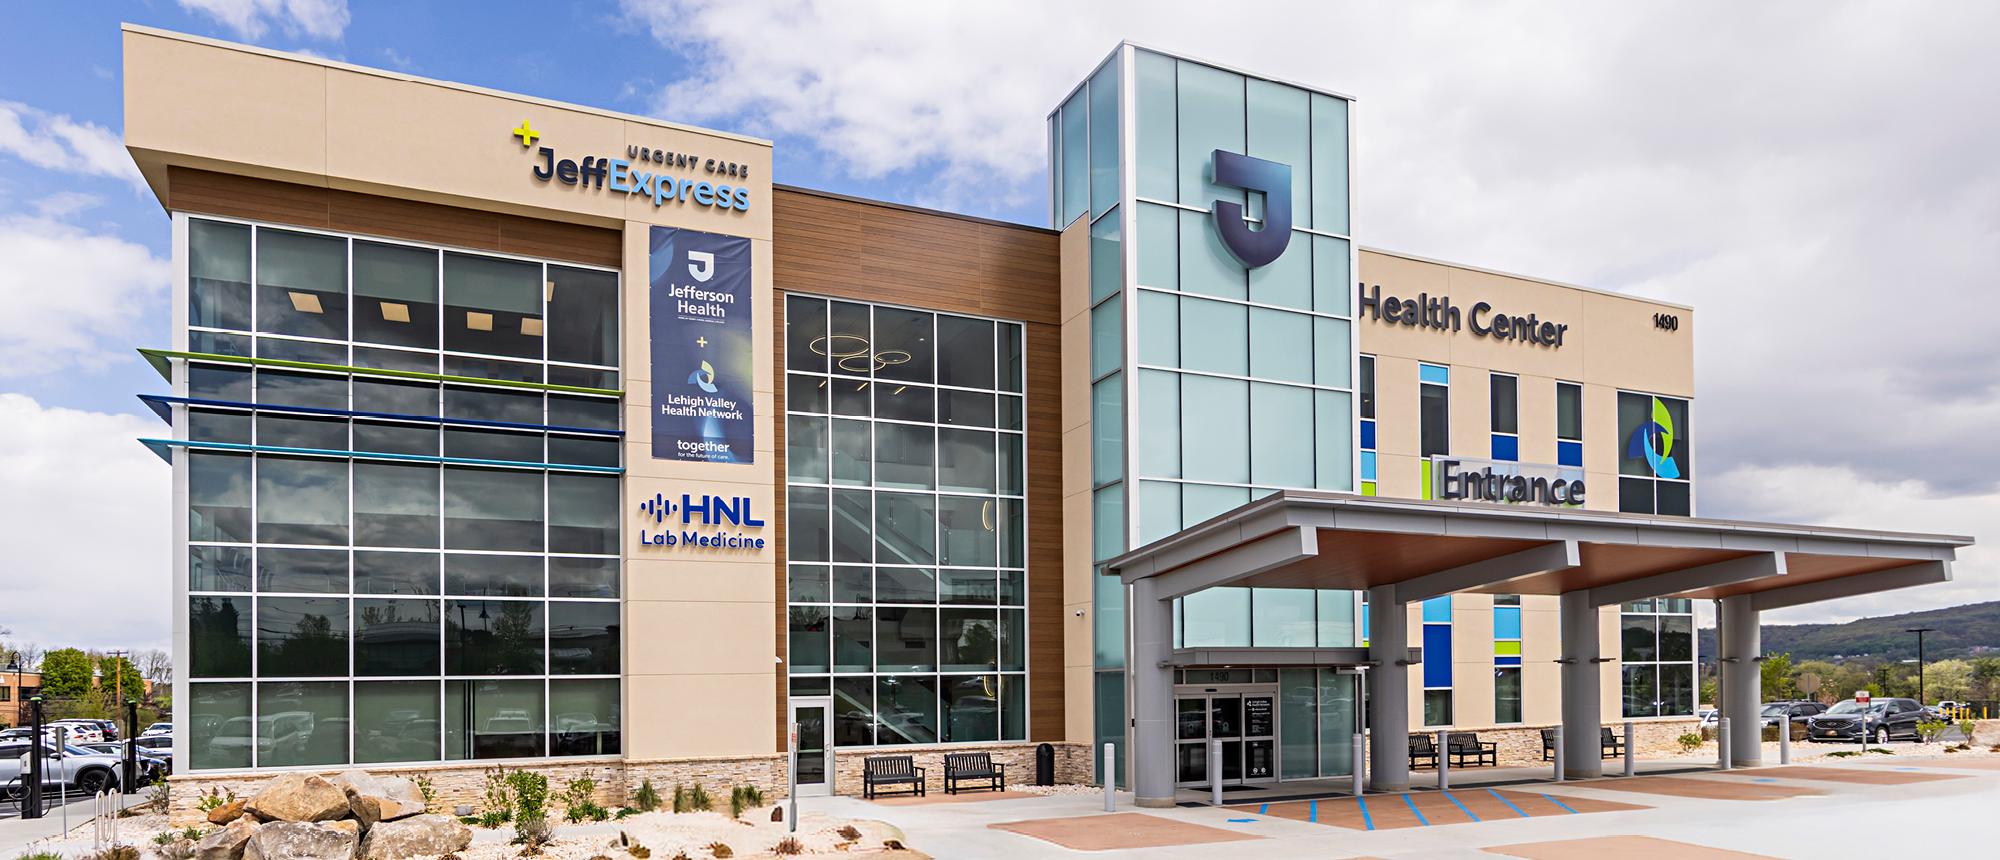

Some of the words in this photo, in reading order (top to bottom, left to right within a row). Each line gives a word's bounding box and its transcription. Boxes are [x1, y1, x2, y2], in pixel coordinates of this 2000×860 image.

[627, 144, 698, 170] URGENT
[705, 158, 749, 178] CARE
[533, 146, 750, 212] JeffExpress
[668, 283, 734, 304] Jefferson
[677, 299, 725, 318] Health
[1359, 282, 1461, 332] Health
[1468, 301, 1568, 348] Center
[1653, 312, 1678, 331] 1490
[661, 404, 697, 417] Health
[698, 407, 743, 420] Network
[668, 394, 704, 408] Lehigh
[705, 397, 737, 411] Valley
[677, 440, 730, 453] together
[1438, 460, 1586, 505] Entrance
[682, 494, 765, 527] HNL
[641, 529, 677, 546] Lab
[682, 530, 765, 549] Medicine
[1210, 671, 1229, 682] 1490
